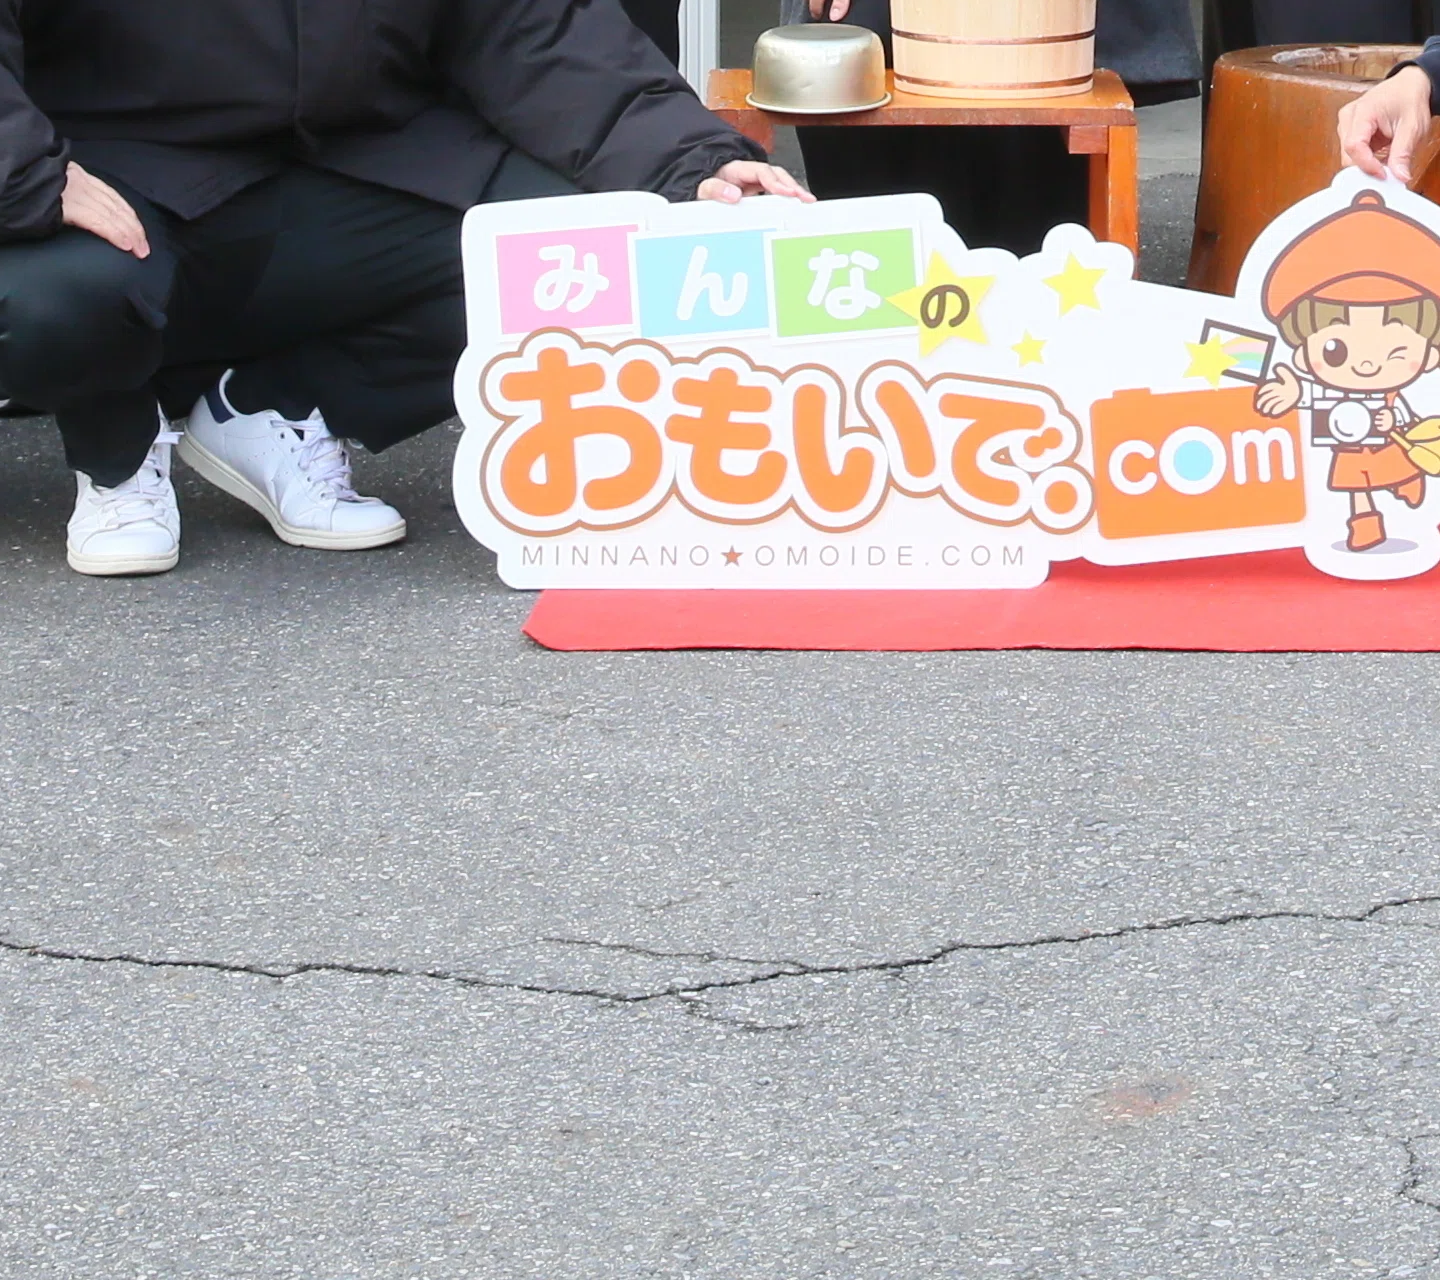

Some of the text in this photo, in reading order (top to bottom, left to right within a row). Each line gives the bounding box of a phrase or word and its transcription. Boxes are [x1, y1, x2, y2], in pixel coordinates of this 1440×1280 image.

[532, 243, 971, 328] みんなの
[522, 544, 1025, 567] MINNANO OMOIDE.COM
